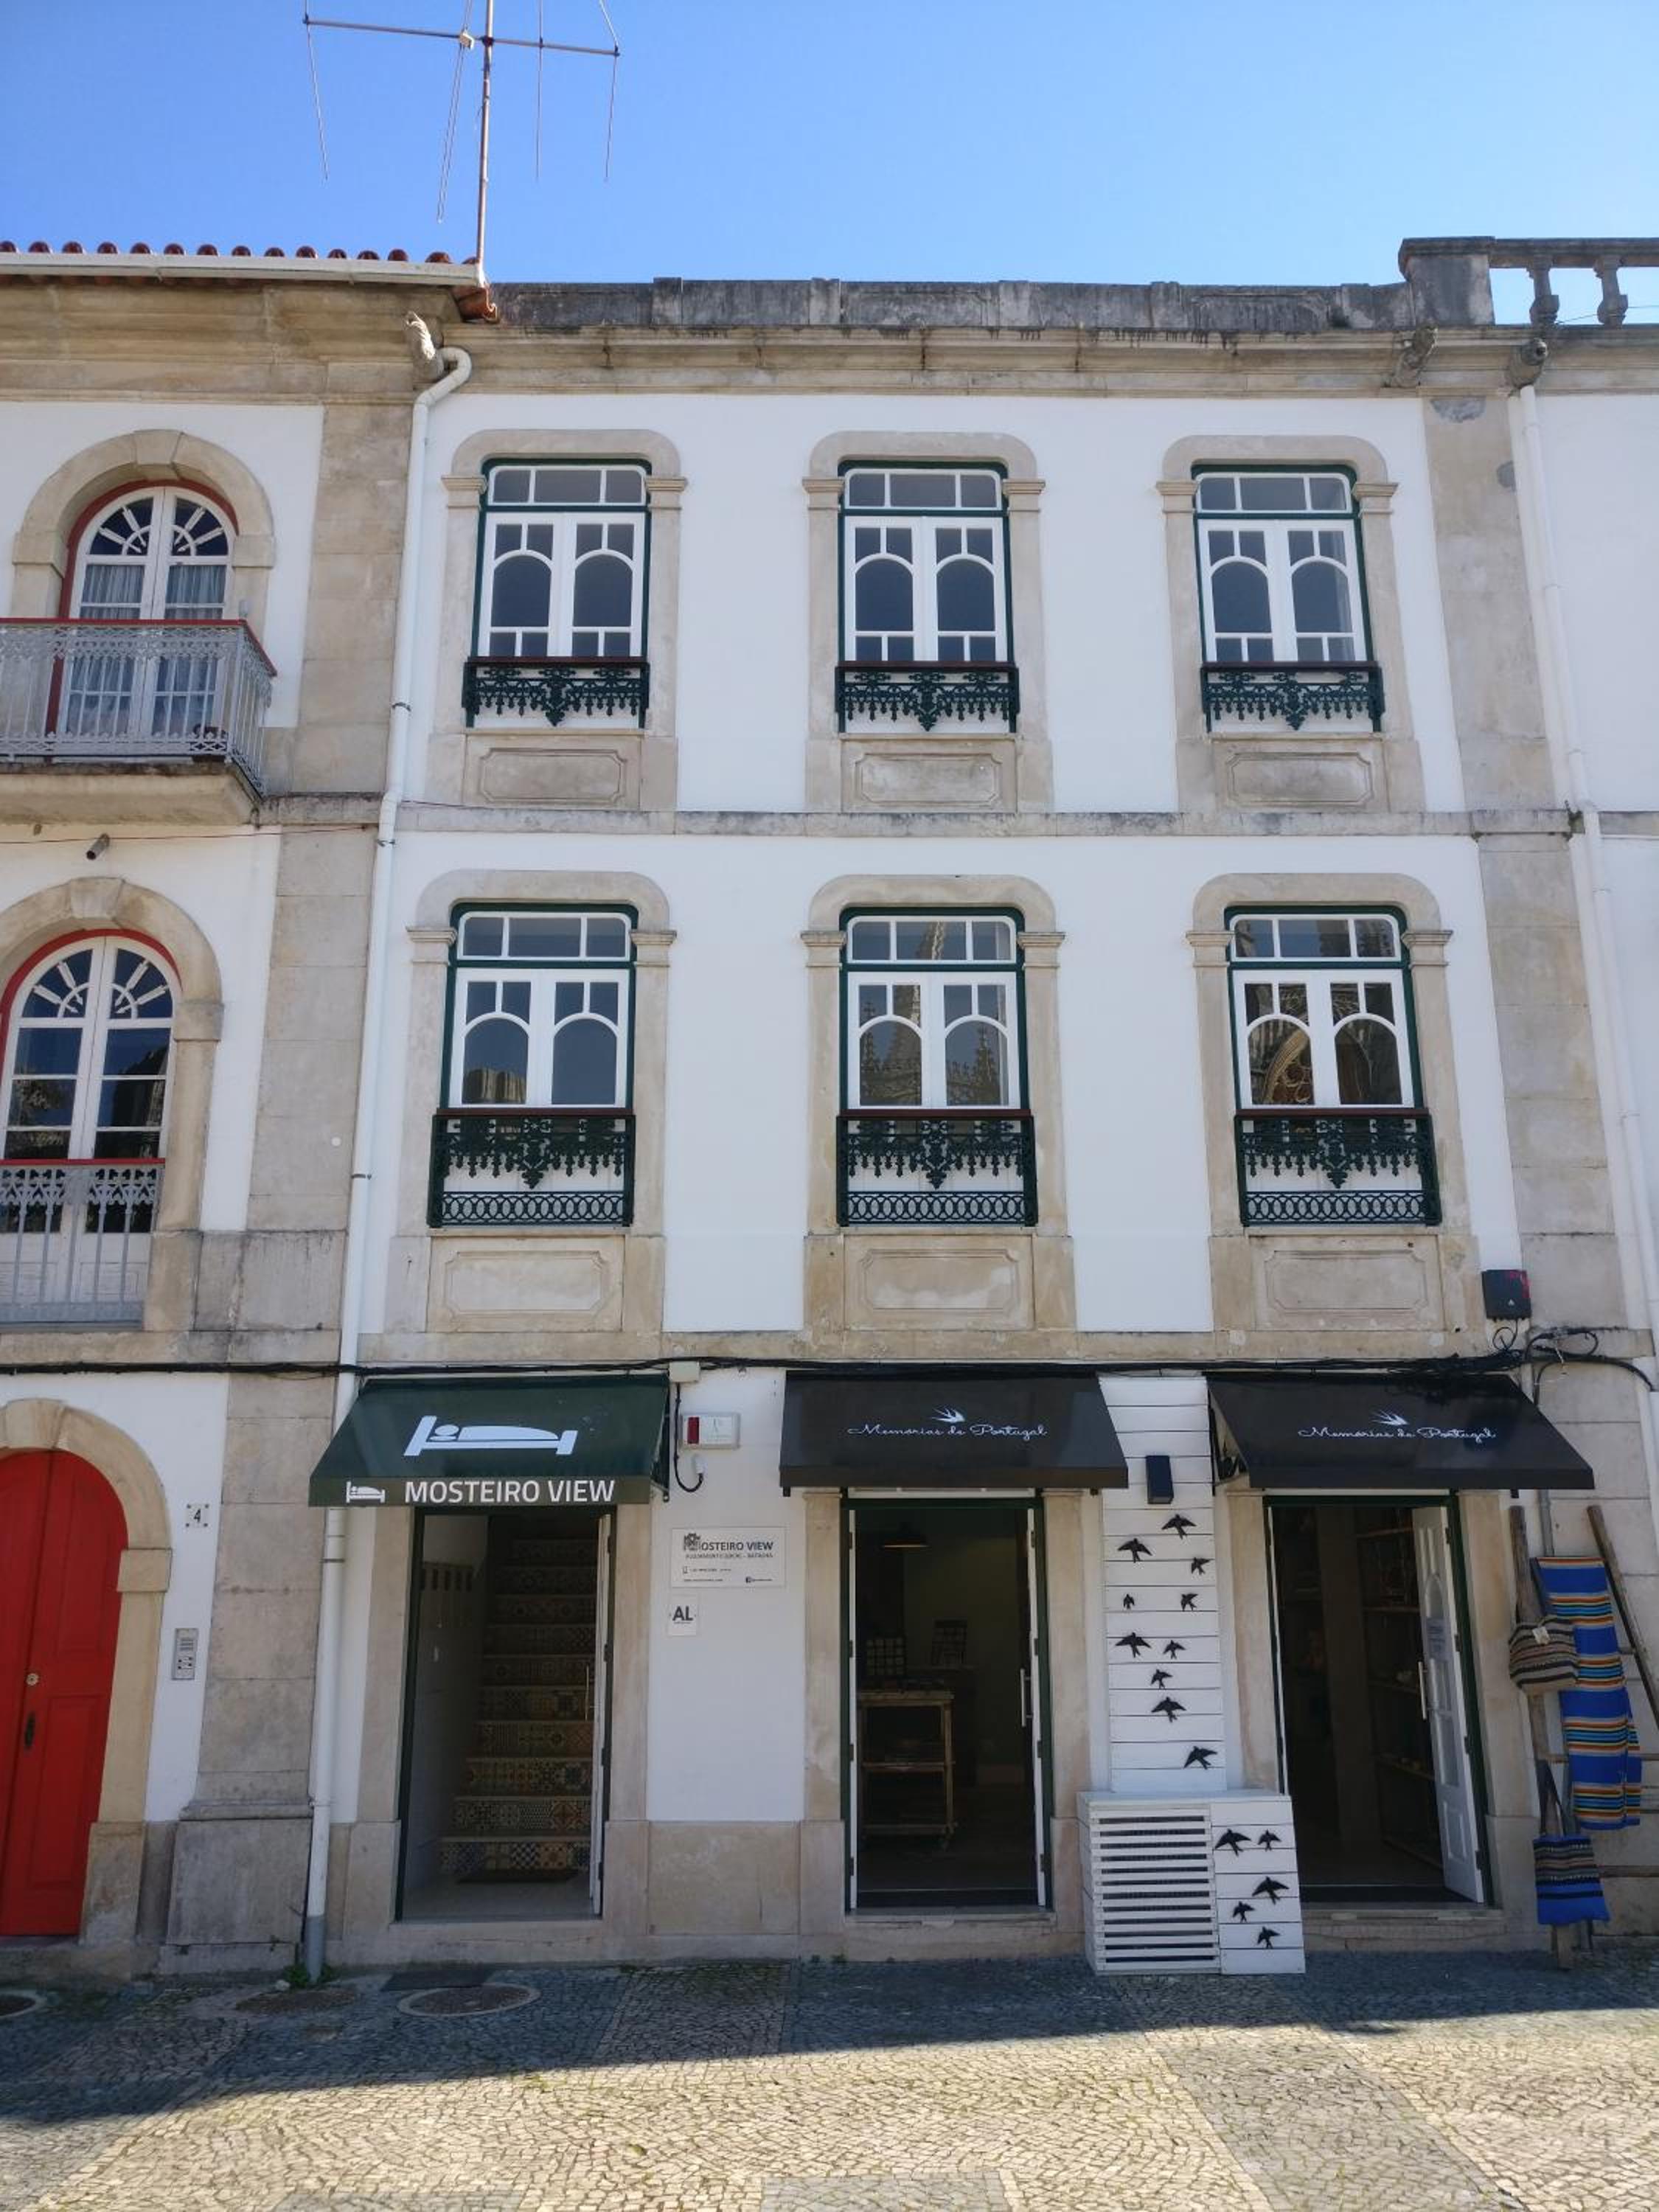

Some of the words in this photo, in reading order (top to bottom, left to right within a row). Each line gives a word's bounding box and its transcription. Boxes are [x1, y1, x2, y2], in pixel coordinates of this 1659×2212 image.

[947, 1425, 966, 1435] de
[969, 1424, 1048, 1441] Portugal
[1397, 1428, 1416, 1437] de
[1416, 1427, 1496, 1443] Portugal
[404, 1481, 540, 1503] MOSTEIRO
[548, 1480, 615, 1502] VIEW
[193, 1509, 201, 1523] 4
[747, 1541, 773, 1551] VIEW
[672, 1605, 694, 1621] AL
